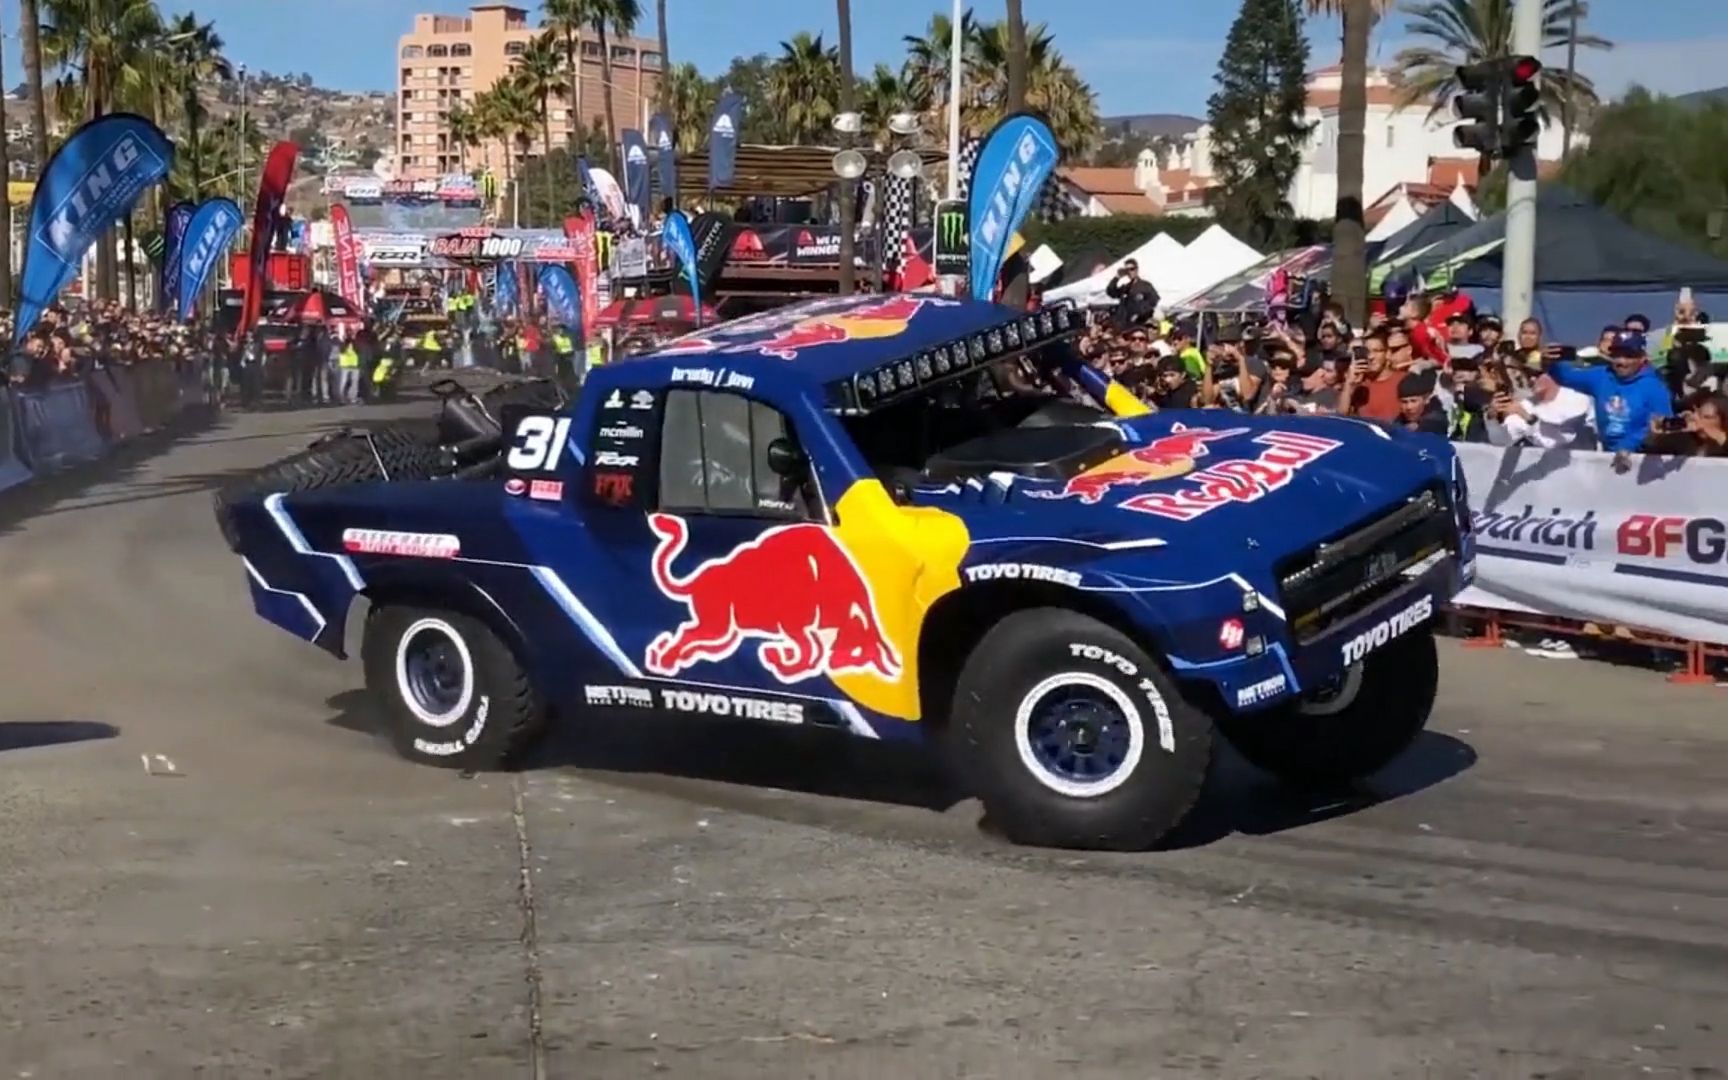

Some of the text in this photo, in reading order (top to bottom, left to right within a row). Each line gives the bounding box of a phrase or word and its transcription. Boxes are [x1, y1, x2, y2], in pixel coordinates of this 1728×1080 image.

[48, 138, 138, 249] KING
[981, 133, 1036, 244] KING
[190, 209, 227, 273] KING
[370, 251, 418, 260] RZR
[482, 238, 522, 256] 1000
[507, 416, 572, 471] 31
[1116, 430, 1344, 521] Red Bull
[1473, 505, 1598, 551] odrich
[1616, 515, 1728, 565] BFG
[965, 563, 1082, 588] TOYO TIRES
[1341, 594, 1433, 666] TOYO TIRES
[661, 689, 804, 724] TOYO TIRES
[1069, 643, 1175, 753] TOYO TIRES
